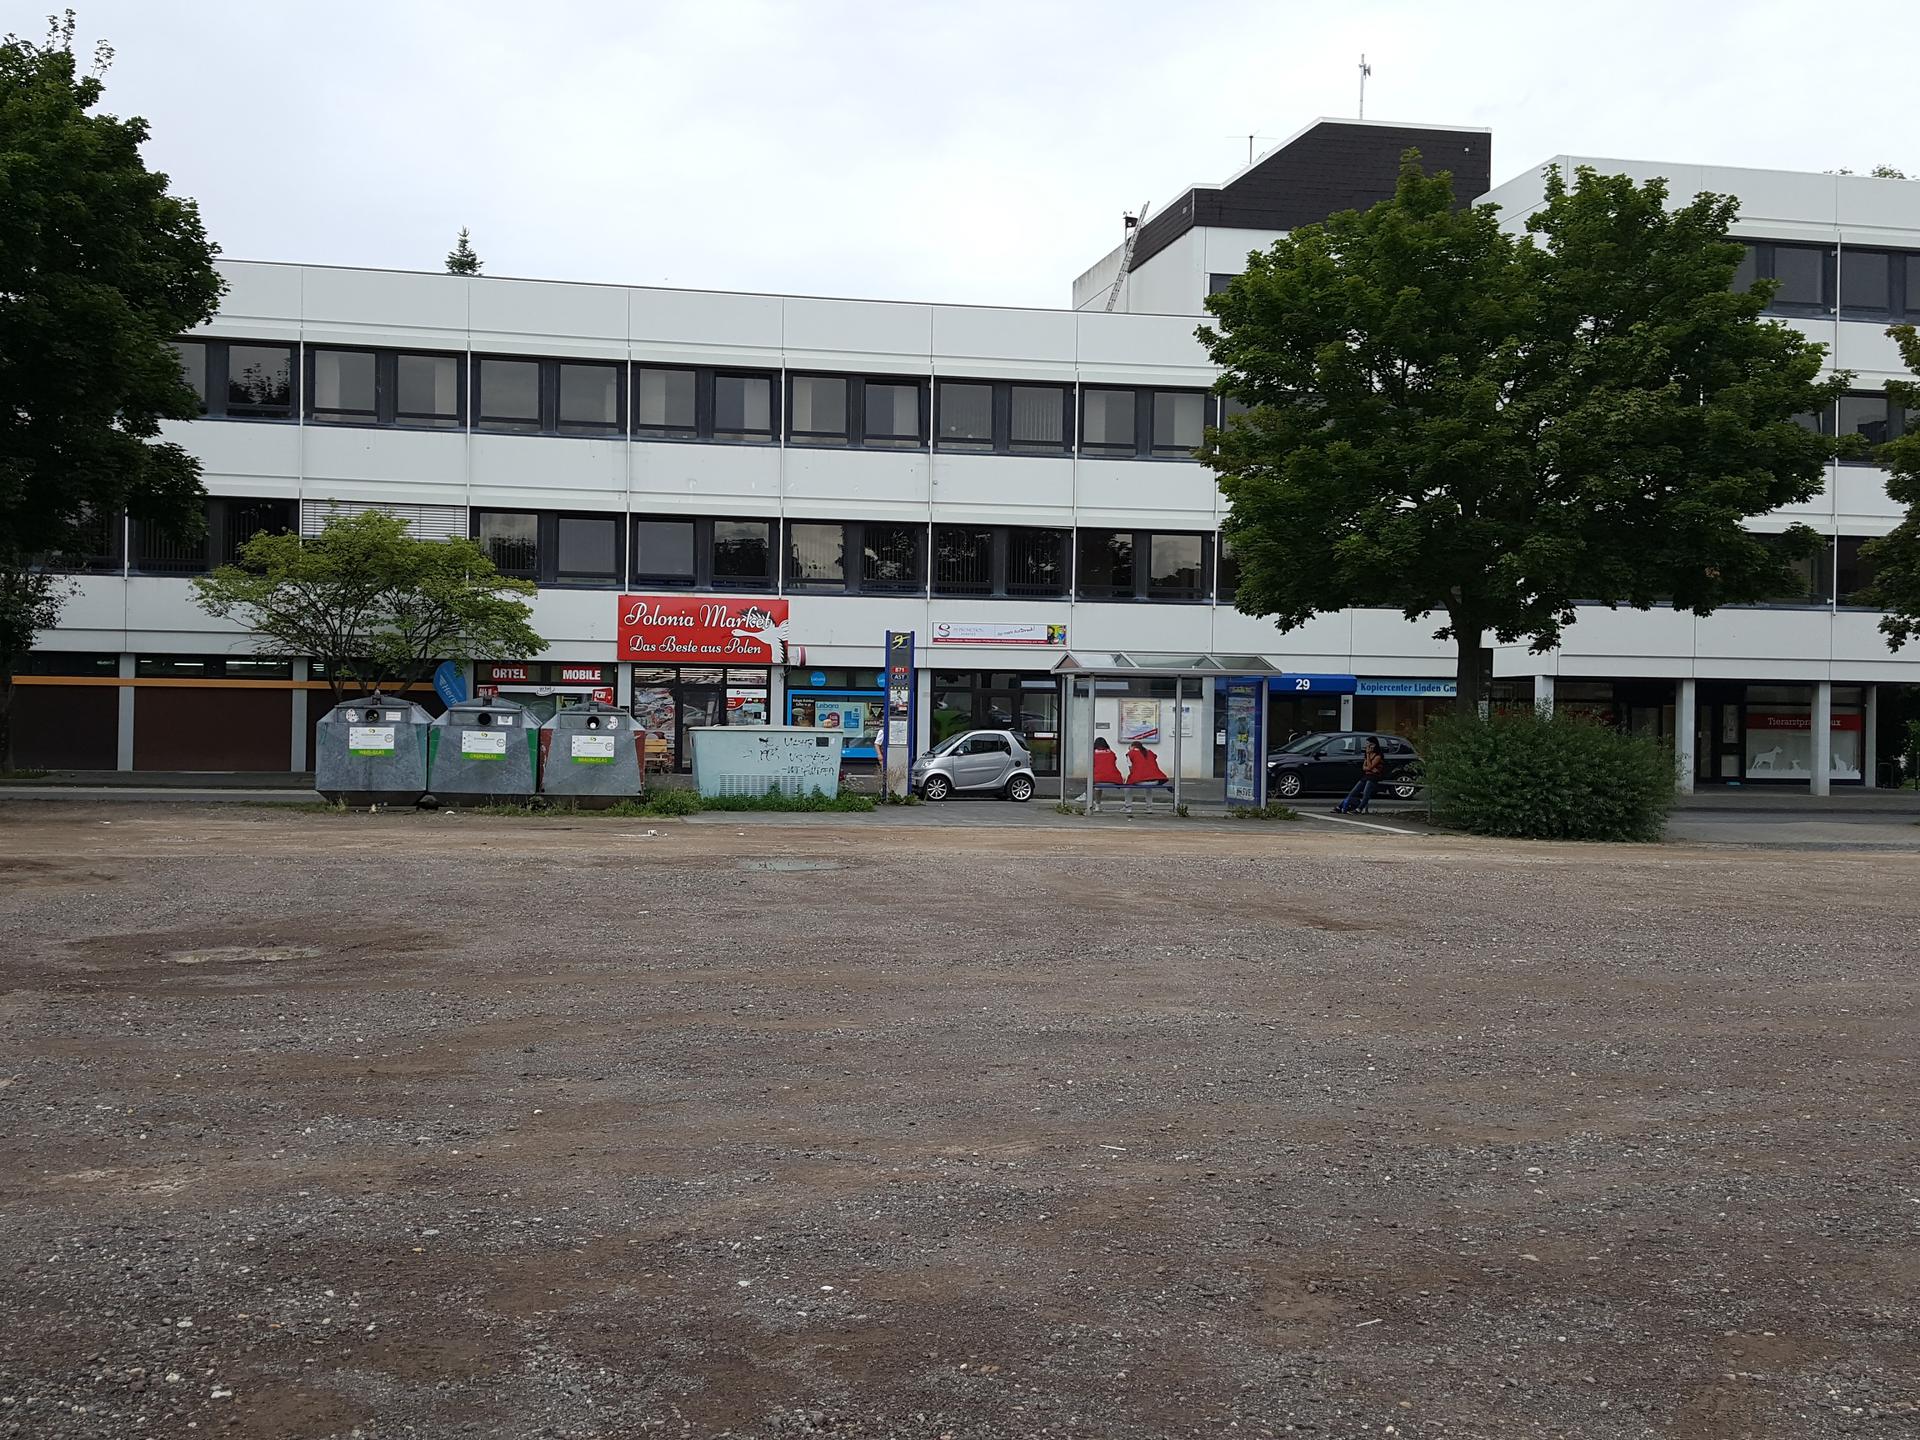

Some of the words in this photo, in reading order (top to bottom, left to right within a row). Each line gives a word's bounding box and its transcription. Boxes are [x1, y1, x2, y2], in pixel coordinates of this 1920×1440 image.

[624, 602, 695, 627] Polonia
[699, 604, 772, 629] Market
[629, 635, 656, 653] Das
[658, 636, 698, 653] Beste
[700, 645, 721, 654] aus
[724, 637, 761, 654] Polen
[492, 668, 526, 679] ORTEL
[562, 669, 601, 680] MOBILE
[1295, 679, 1311, 690] 29
[1360, 682, 1412, 693] Kopiercenter
[1414, 683, 1441, 692] Linden
[1443, 684, 1457, 692] Gm
[441, 683, 458, 705] Herm
[1767, 717, 1811, 727] Tierarztpra
